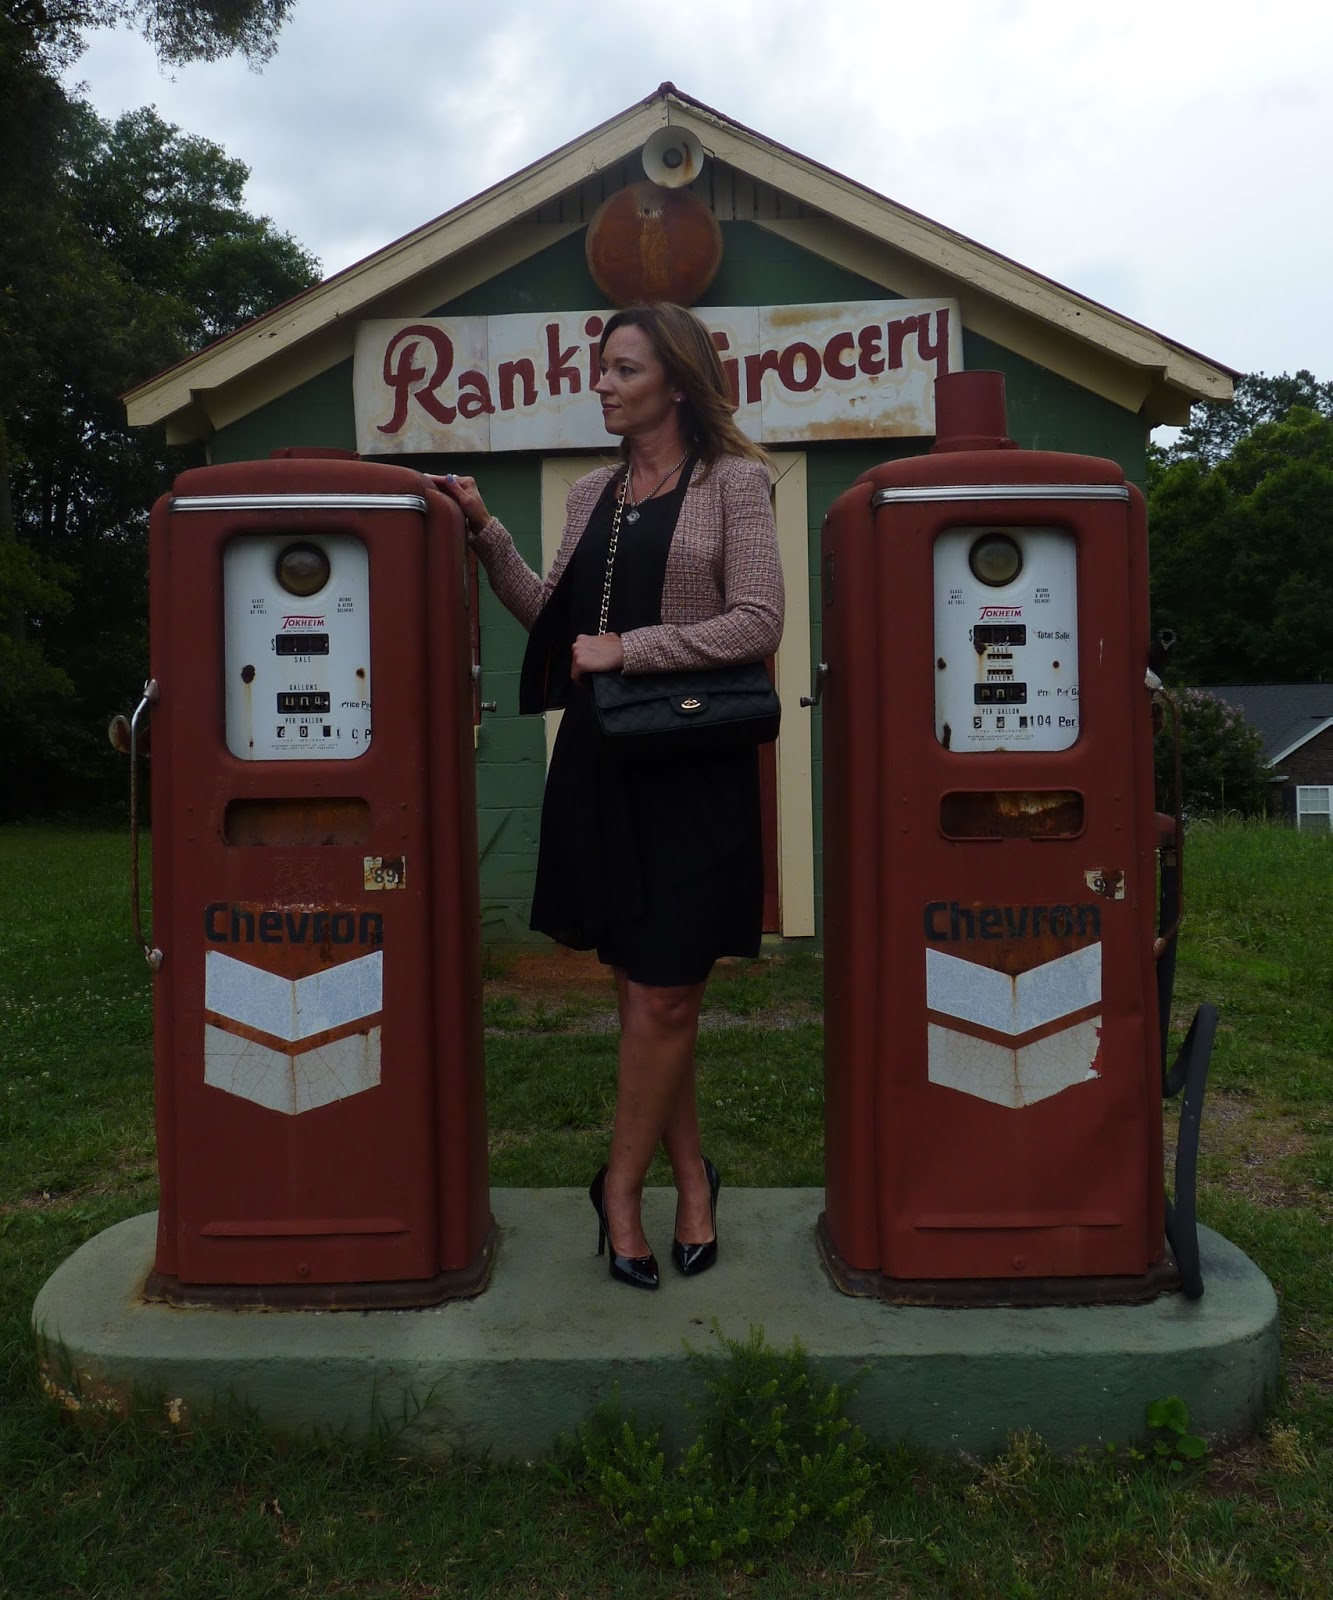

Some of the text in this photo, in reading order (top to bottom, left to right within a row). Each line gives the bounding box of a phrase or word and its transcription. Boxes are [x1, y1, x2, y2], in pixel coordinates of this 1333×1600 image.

[376, 315, 604, 434] Ranki
[281, 615, 326, 630] TOKHEIM
[978, 605, 1023, 620] TOKHEIM
[1058, 716, 1076, 727] Per
[204, 902, 384, 944] Chevron
[923, 901, 1101, 941] Chevron
